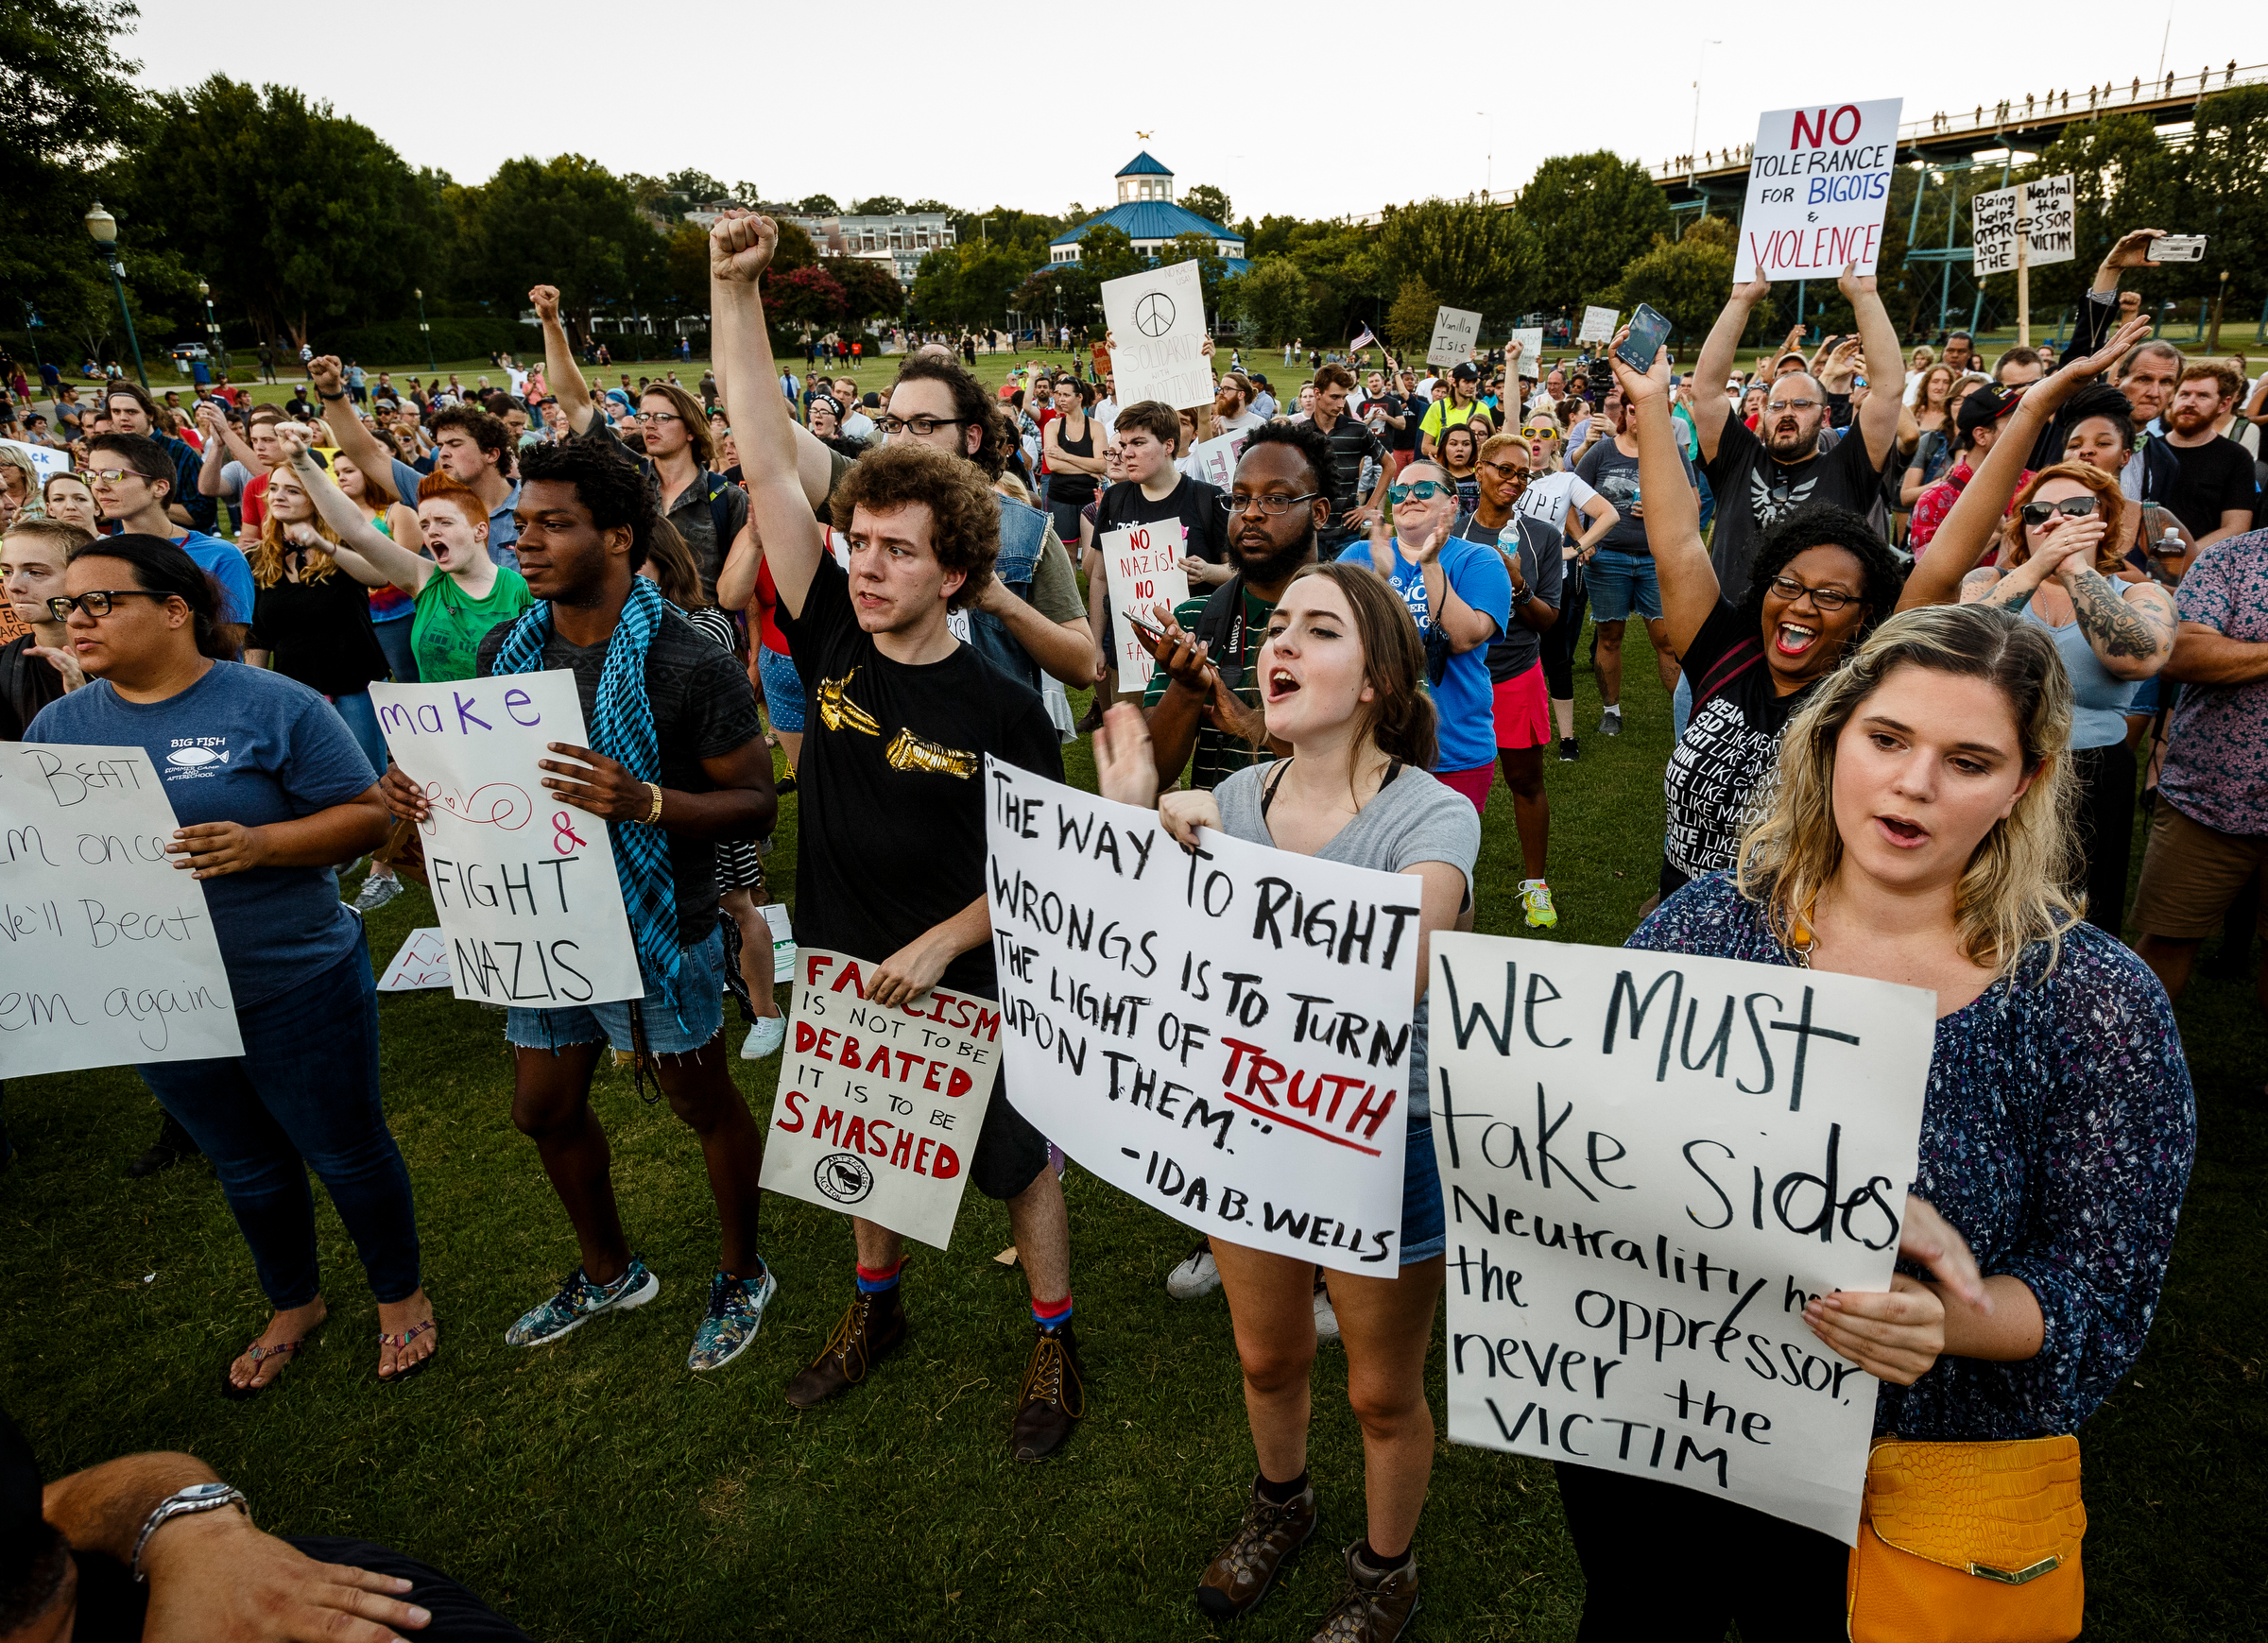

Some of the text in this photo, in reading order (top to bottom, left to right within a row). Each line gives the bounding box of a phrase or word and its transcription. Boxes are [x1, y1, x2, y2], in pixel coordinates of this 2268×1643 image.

[1791, 105, 1861, 150] NO
[1755, 145, 1888, 179] TOLERANCE
[1761, 172, 1890, 205] FOR BIGOTS
[1975, 178, 2070, 212] Being Neutral
[1979, 199, 2059, 226] helps the
[1750, 224, 1881, 269] VIOLENCE
[1979, 241, 2011, 256] NOT
[2031, 231, 2071, 251] VICTIM
[1176, 262, 1195, 276] RACIST
[1976, 253, 2011, 271] THE
[1435, 336, 1467, 352] Isis
[1440, 313, 1471, 334] Vanilla
[1123, 334, 1198, 372] SOLIDARITY
[1152, 370, 1169, 379] WITH
[1518, 488, 1560, 521] OPE
[1129, 529, 1150, 551] NO
[1136, 580, 1154, 599] NO
[1228, 615, 1243, 654] Canon
[380, 690, 541, 735] make
[171, 737, 226, 747] BIG FISH
[21, 749, 139, 807] BEAT
[166, 772, 215, 781] AFTERSCHOOL
[1665, 759, 1690, 788] RITE
[1690, 776, 1727, 803] LIKE
[1681, 791, 1714, 818] LIKE
[1685, 810, 1718, 832] LIKE
[77, 834, 174, 864] once
[552, 812, 587, 855] &
[1705, 832, 1742, 854] LIKE
[1691, 847, 1725, 869] LIKE
[433, 857, 579, 916] FIGHT
[1057, 803, 1155, 881] WAY
[1179, 841, 1233, 917] TO
[1253, 877, 1420, 971] RIGHT
[78, 899, 200, 948] Beat
[391, 972, 451, 987] NO
[455, 938, 593, 1001] NAZIS
[992, 854, 1413, 1068] WRONGS IS TO TURN
[105, 980, 228, 1052] again
[807, 956, 1001, 1043] FACISM
[1439, 954, 1573, 1057] We
[803, 991, 989, 1065] IS NOT TO BE
[995, 929, 1398, 1140] THE LIGHT OF TRUTH
[1002, 987, 1087, 1076] UPON
[796, 1020, 973, 1098] DEBATED
[798, 1064, 957, 1131] IT IS TO BE
[776, 1090, 960, 1179] SMASHED
[1432, 1066, 1638, 1203] take
[818, 1175, 842, 1200] ACTION
[828, 1155, 869, 1189] ANTIFASCIST
[1263, 1202, 1397, 1264] WELLS
[1446, 1244, 1529, 1308] the
[1452, 1185, 1768, 1342] Neutrality
[1453, 1333, 1772, 1446] never the
[1485, 1396, 1728, 1489] VICTIM
